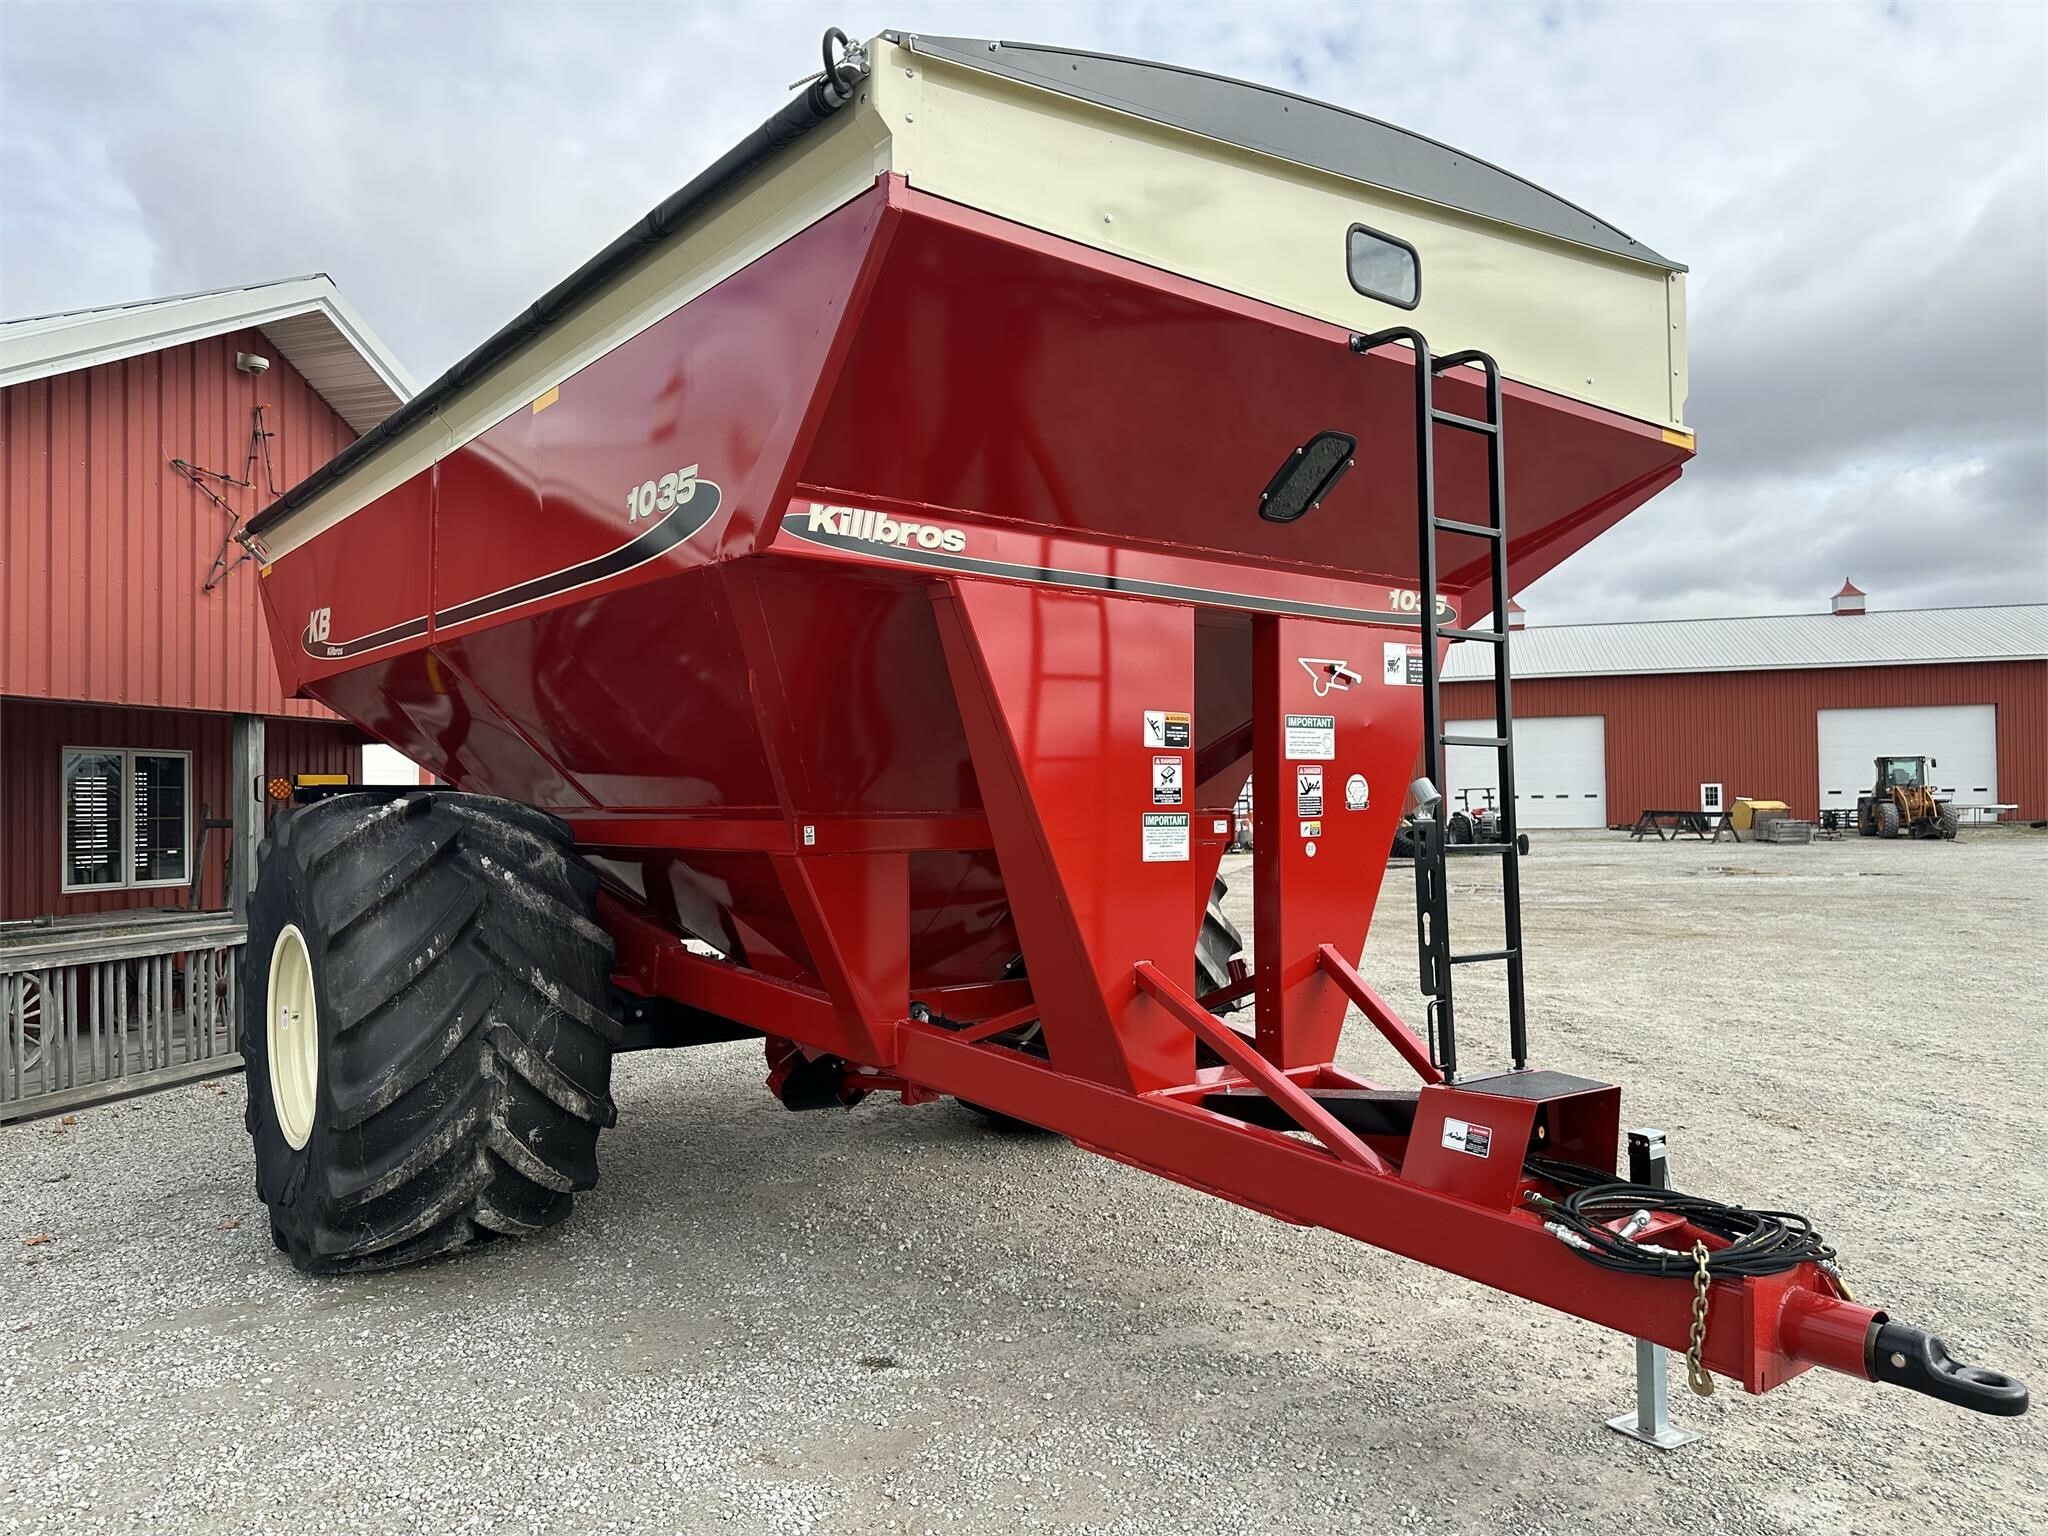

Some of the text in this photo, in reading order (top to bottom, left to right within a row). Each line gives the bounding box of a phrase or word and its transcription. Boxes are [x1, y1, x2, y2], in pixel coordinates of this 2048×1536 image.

[627, 464, 698, 524] 1035
[808, 503, 966, 552] Killbros
[309, 607, 331, 643] KB
[1288, 717, 1332, 727] IMPORTANT
[1145, 815, 1187, 826] IMPORTANT
